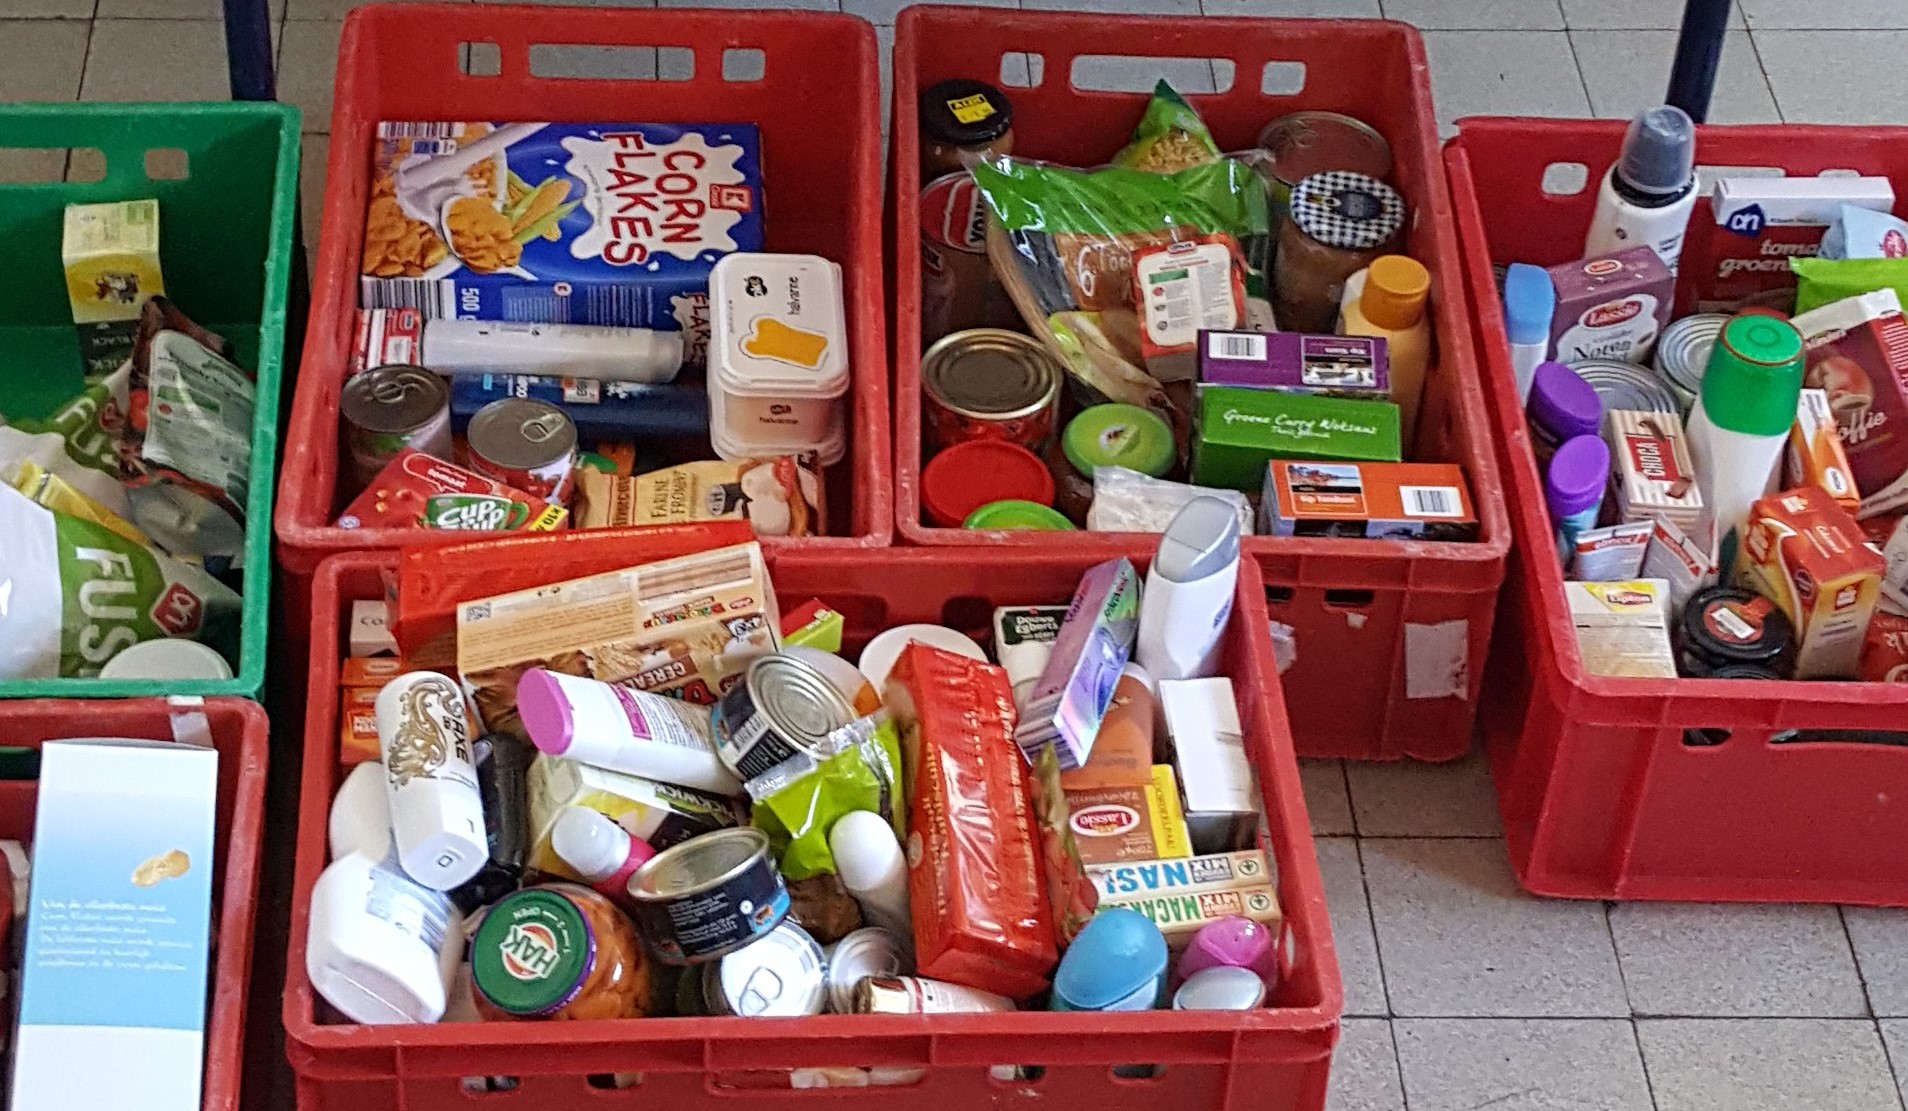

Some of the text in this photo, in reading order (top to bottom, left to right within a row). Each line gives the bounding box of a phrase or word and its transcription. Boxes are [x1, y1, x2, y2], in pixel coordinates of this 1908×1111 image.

[599, 131, 657, 265] FLAKES
[655, 149, 705, 244] CORN
[460, 287, 481, 312] 500
[1836, 410, 1889, 444] offie
[1641, 442, 1666, 478] CHOCA
[1015, 622, 1060, 634] Egberts
[1016, 615, 1055, 625] Douwe
[452, 716, 470, 764] AXE
[1079, 811, 1130, 828] Lassie
[512, 907, 542, 922] OPEN
[499, 924, 560, 981] HAK
